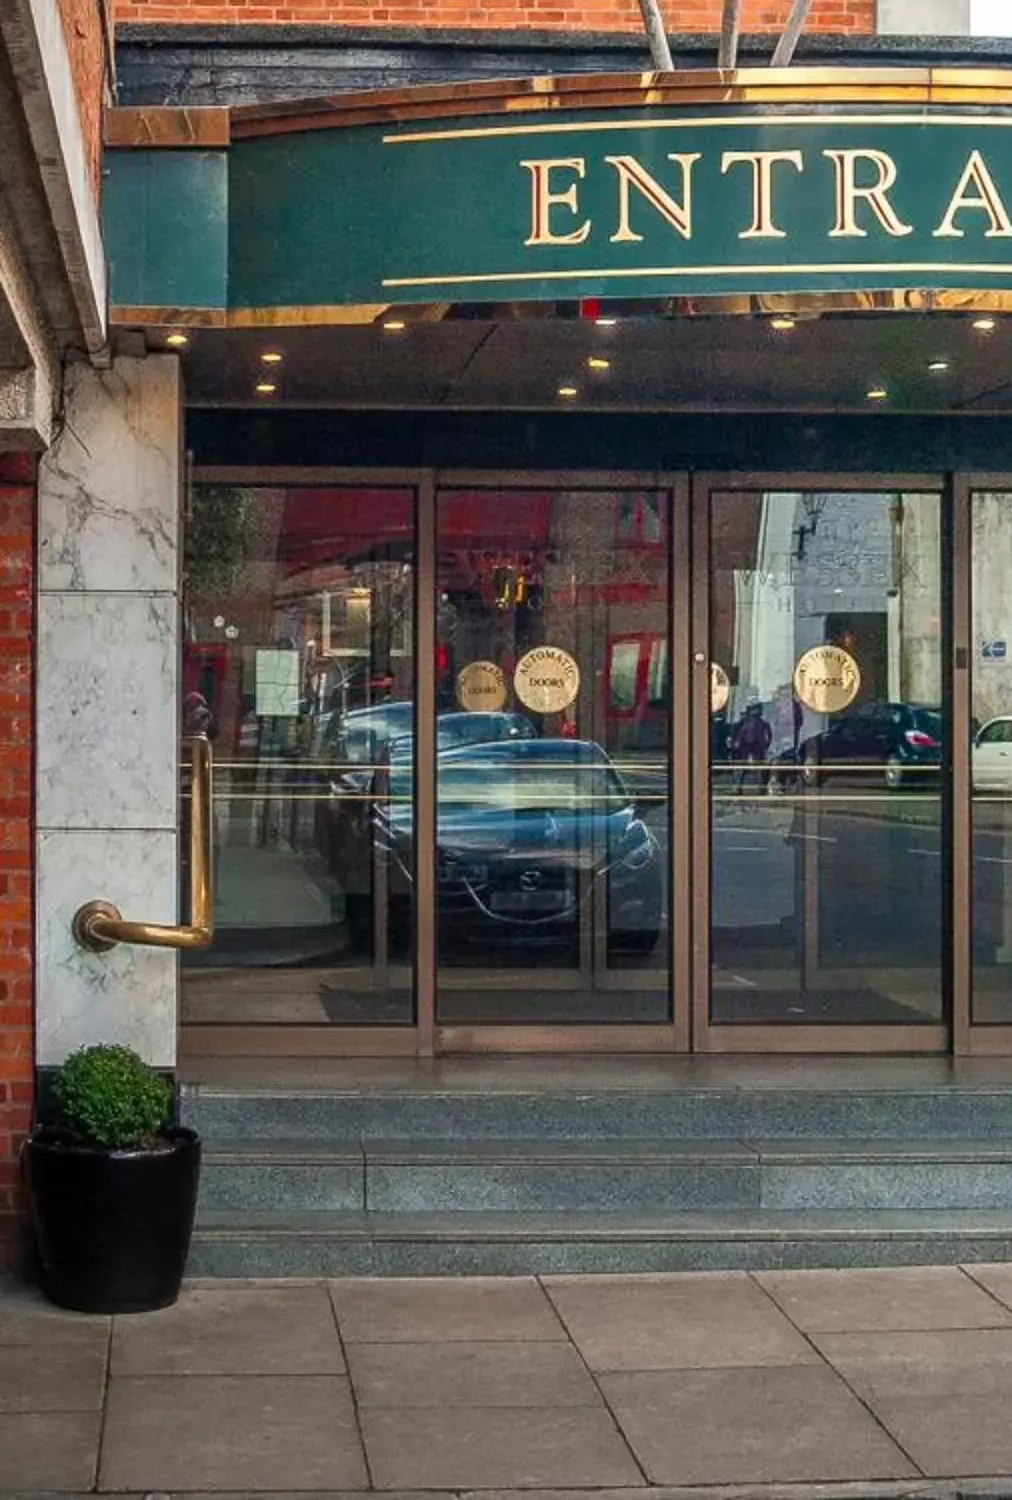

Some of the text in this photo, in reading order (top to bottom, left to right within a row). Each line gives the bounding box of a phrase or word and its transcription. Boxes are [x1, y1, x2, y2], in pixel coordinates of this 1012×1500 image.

[519, 649, 575, 677] AUTOMATIC
[529, 677, 565, 688] DOORS
[809, 677, 843, 687] DOORS
